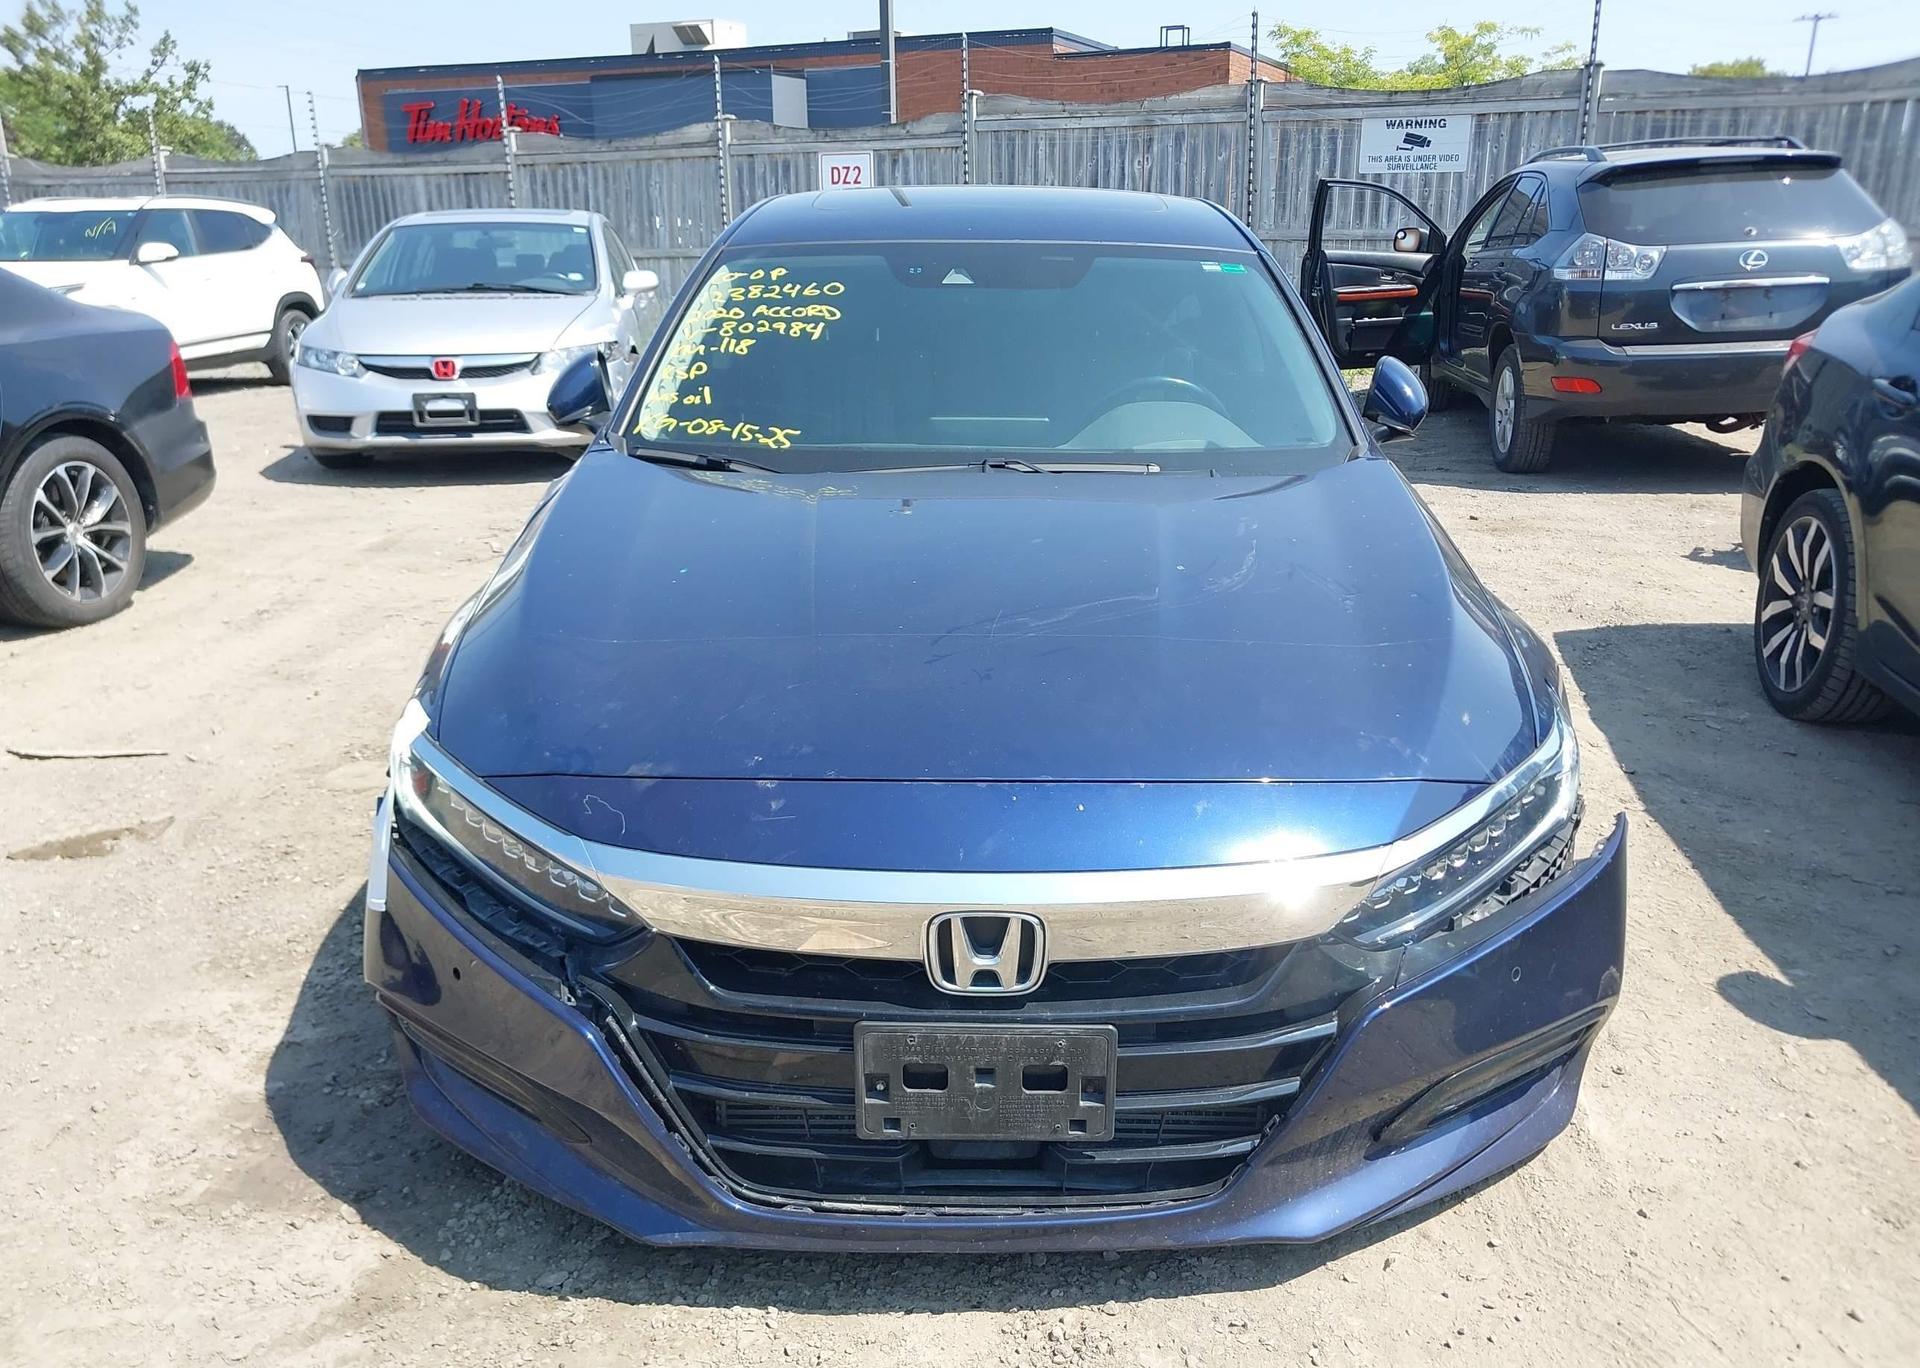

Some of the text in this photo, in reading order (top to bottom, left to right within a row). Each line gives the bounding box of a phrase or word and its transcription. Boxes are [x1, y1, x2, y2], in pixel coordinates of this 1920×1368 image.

[401, 101, 452, 144] Tim
[1386, 119, 1447, 129] WARNING
[1368, 154, 1460, 163] THIS AREA IS UNDER VIDEO
[1387, 163, 1438, 171] SURVEILLANCE
[831, 166, 862, 185] DZ2
[85, 217, 117, 239] N/A
[752, 304, 841, 320] ACCORD
[1611, 322, 1658, 330] LEXUS
[682, 386, 712, 405] oil
